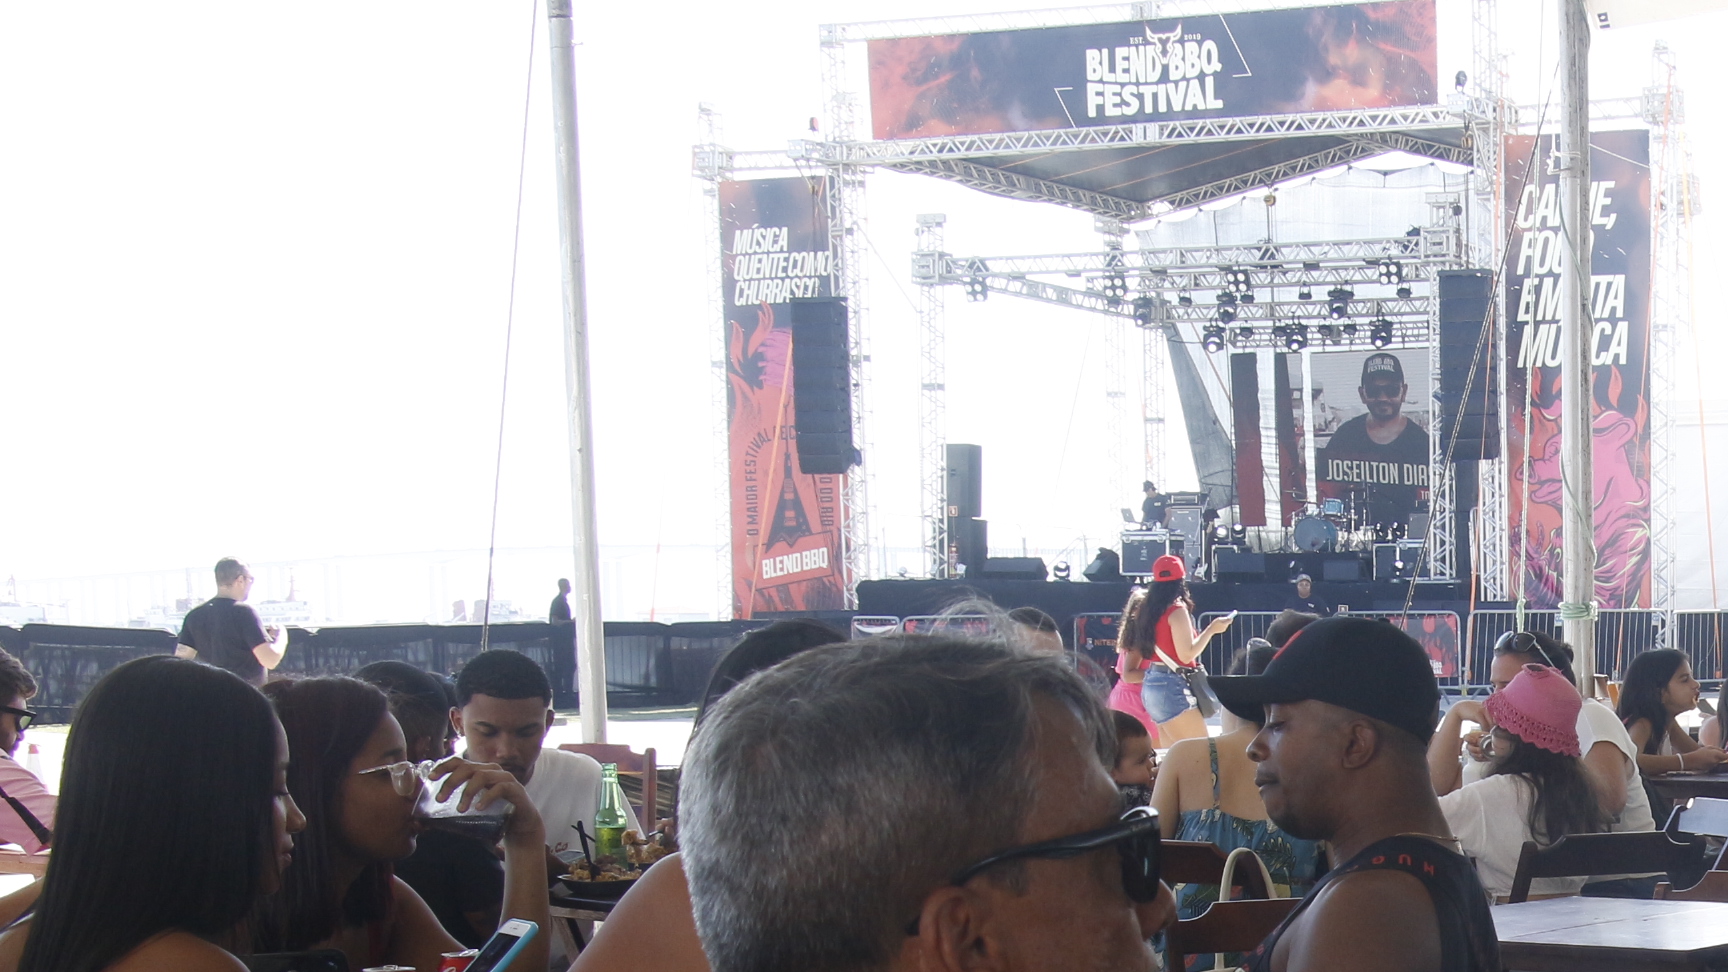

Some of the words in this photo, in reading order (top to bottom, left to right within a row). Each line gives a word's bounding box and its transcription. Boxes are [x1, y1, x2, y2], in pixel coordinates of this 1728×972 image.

[1086, 45, 1162, 83] BLEND
[1169, 40, 1222, 81] BBQ
[1086, 75, 1224, 118] FESTIVAL
[732, 223, 788, 254] MÚSICA
[733, 252, 788, 280] QUENTE
[788, 250, 832, 278] COMO
[1517, 278, 1536, 322] E
[1326, 459, 1399, 484] JOSEILTON
[762, 553, 802, 580] BLEND
[802, 547, 828, 570] BBQ
